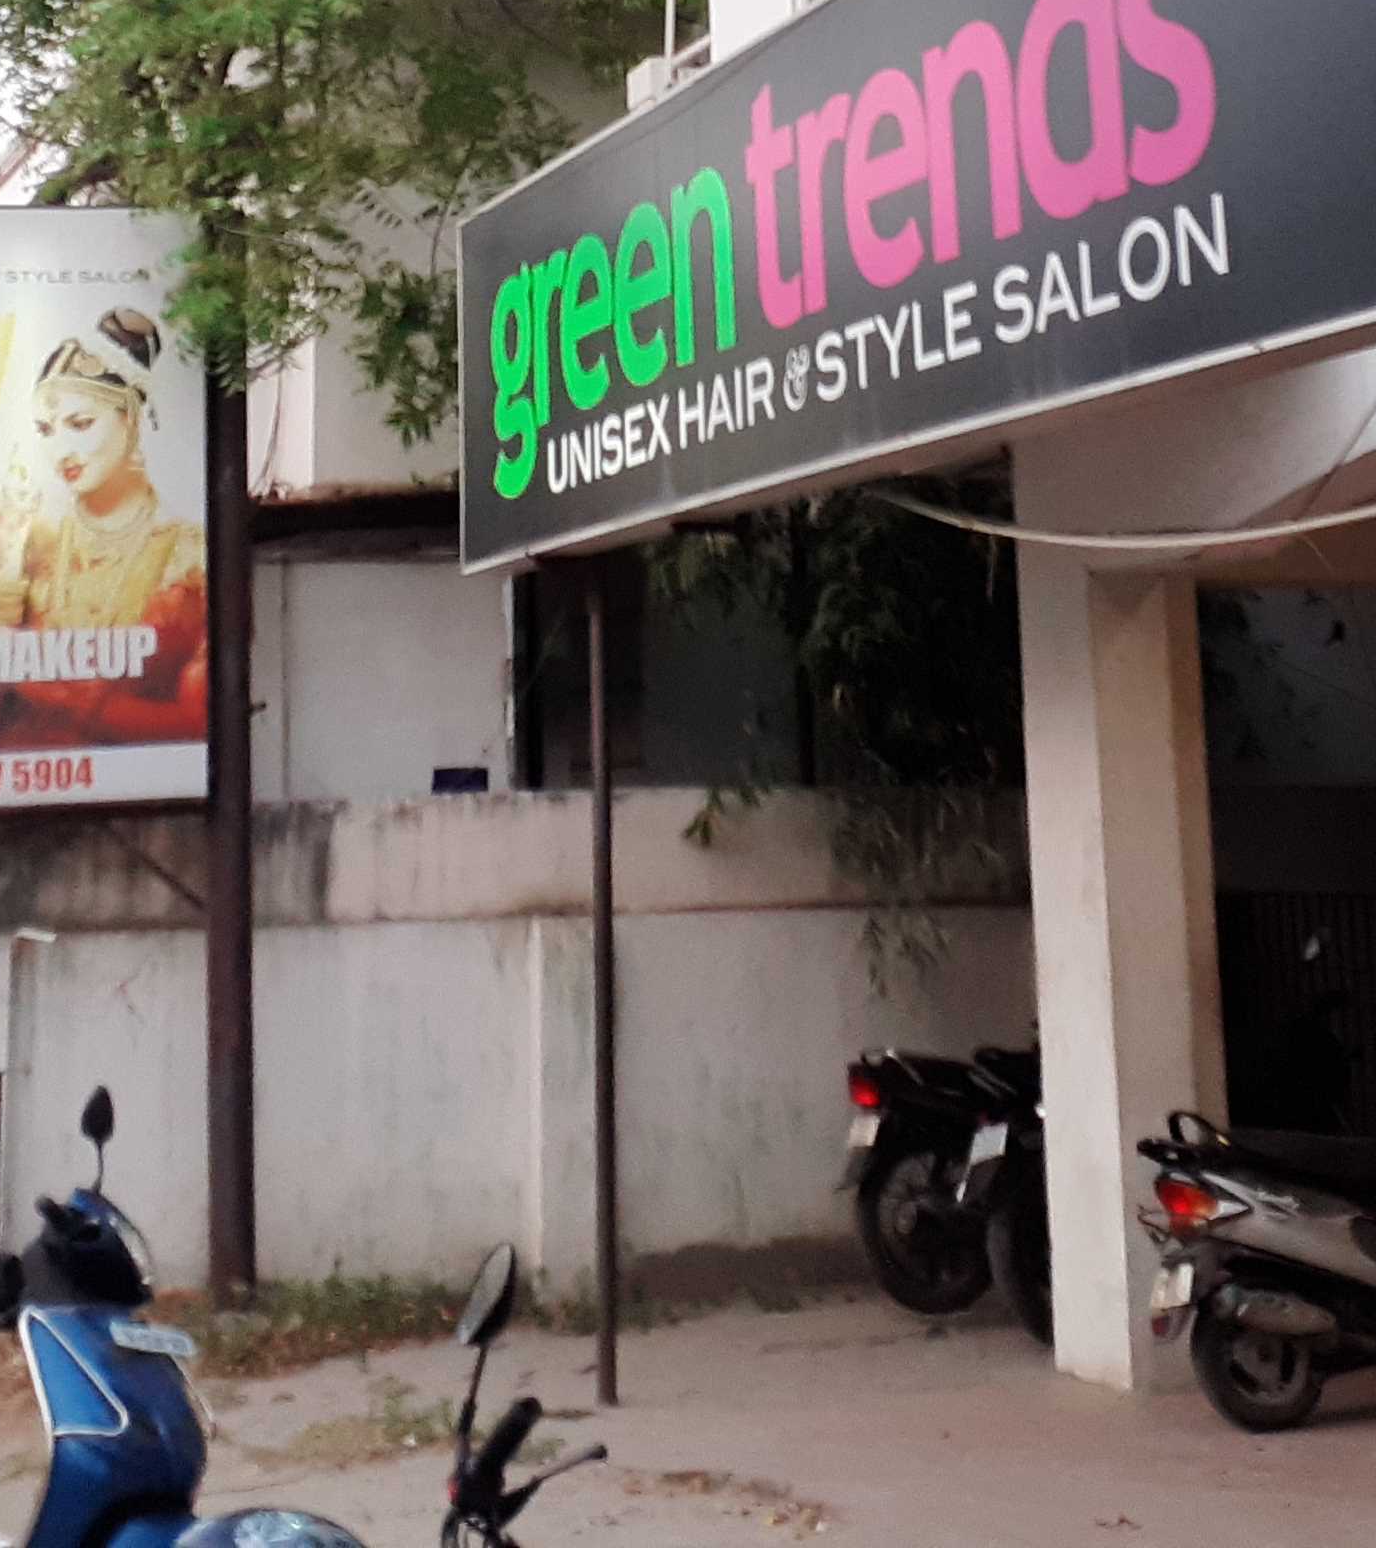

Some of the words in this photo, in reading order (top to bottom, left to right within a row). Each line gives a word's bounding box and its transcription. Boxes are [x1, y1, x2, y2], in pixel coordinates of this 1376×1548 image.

[4, 268, 74, 285] STYLE
[490, 165, 738, 501] green
[546, 392, 673, 494] UNISEX
[677, 356, 776, 451] HAIR
[782, 342, 812, 413] &
[814, 280, 983, 404] STYLE
[991, 191, 1230, 344] SALON
[10, 755, 95, 793] 5904
